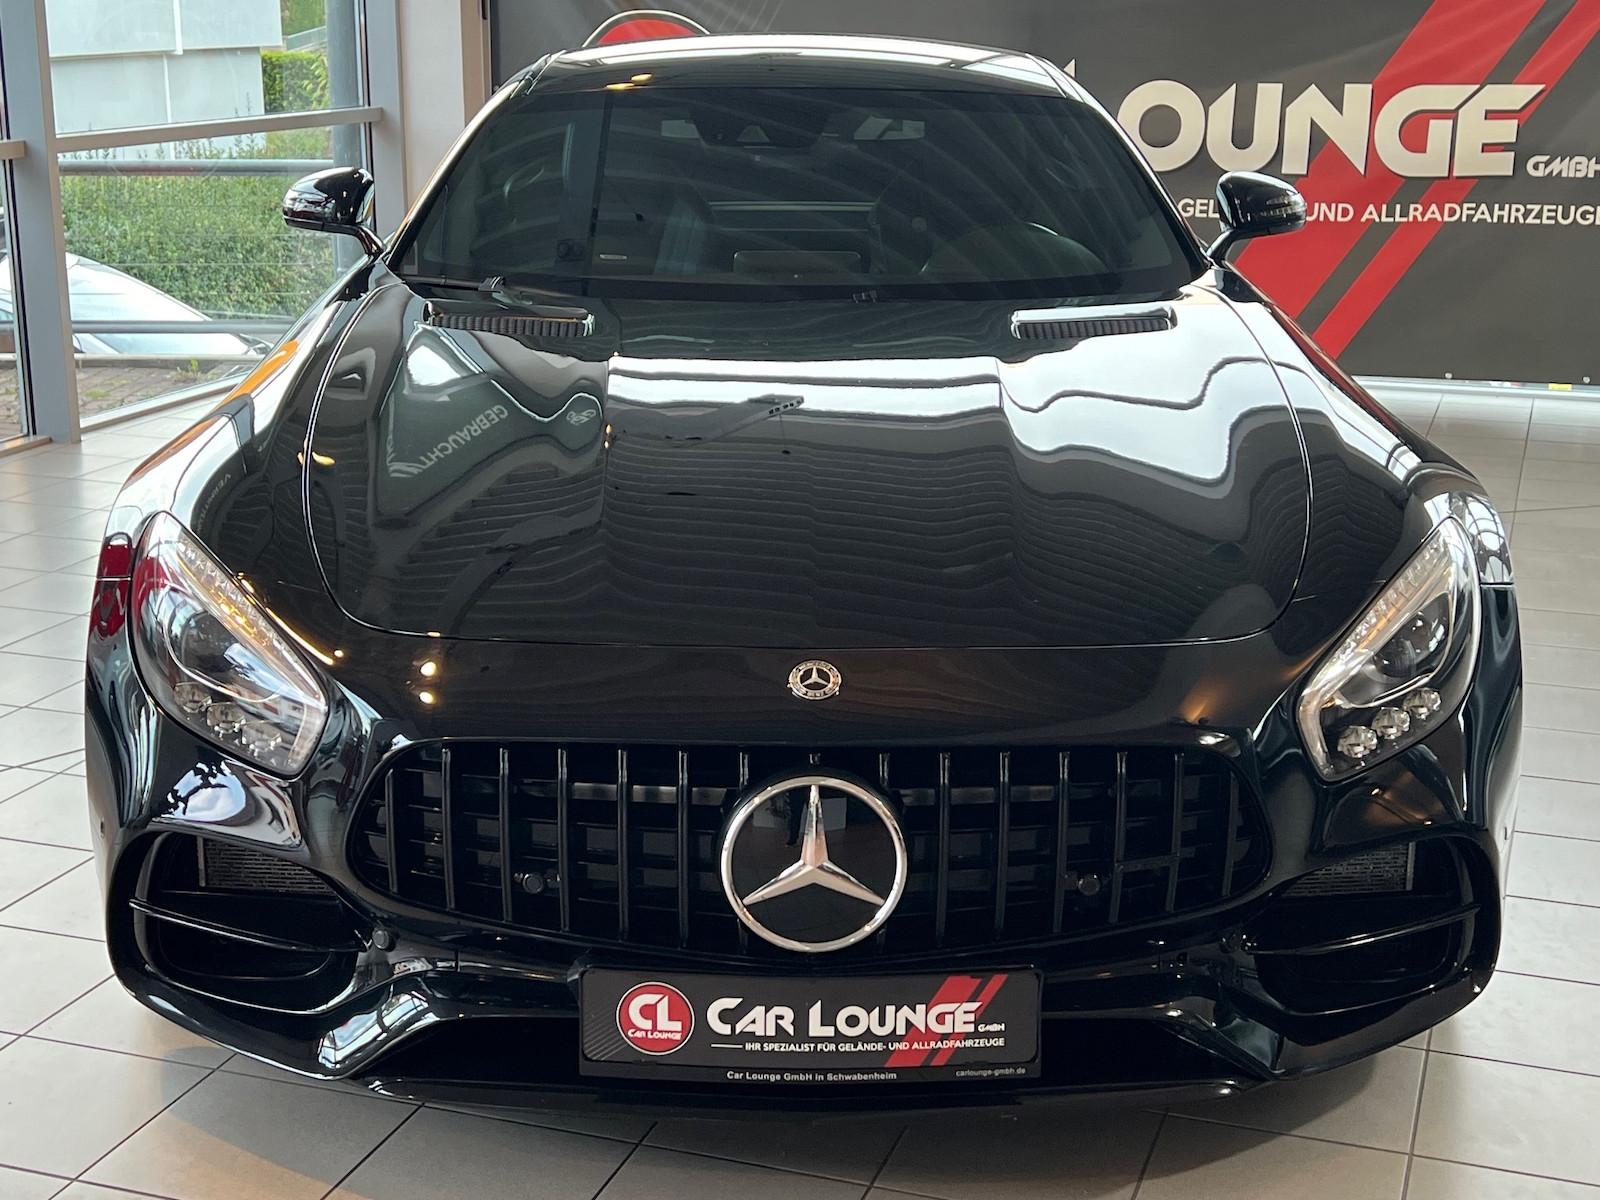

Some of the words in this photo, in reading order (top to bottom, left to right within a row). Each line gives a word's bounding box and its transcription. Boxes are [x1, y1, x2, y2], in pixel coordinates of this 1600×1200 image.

[1116, 80, 1546, 178] OUNGE
[1307, 202, 1354, 223] UND
[628, 993, 682, 1031] CL
[706, 997, 795, 1037] CAR
[808, 999, 983, 1037] LOUNGE
[745, 1042, 761, 1050] IHR
[763, 1042, 816, 1052] SPEZIALIST
[817, 1041, 836, 1052] FÜR
[838, 1041, 887, 1052] GELÄNDE-
[889, 1041, 909, 1051] UND
[911, 1037, 1005, 1050] ALLRADFAHRZEUGE
[726, 1070, 744, 1080] Car
[745, 1071, 781, 1082] Lounge
[783, 1072, 813, 1081] GmbH
[815, 1073, 824, 1081] in
[826, 1071, 897, 1081] Schwabenheim
